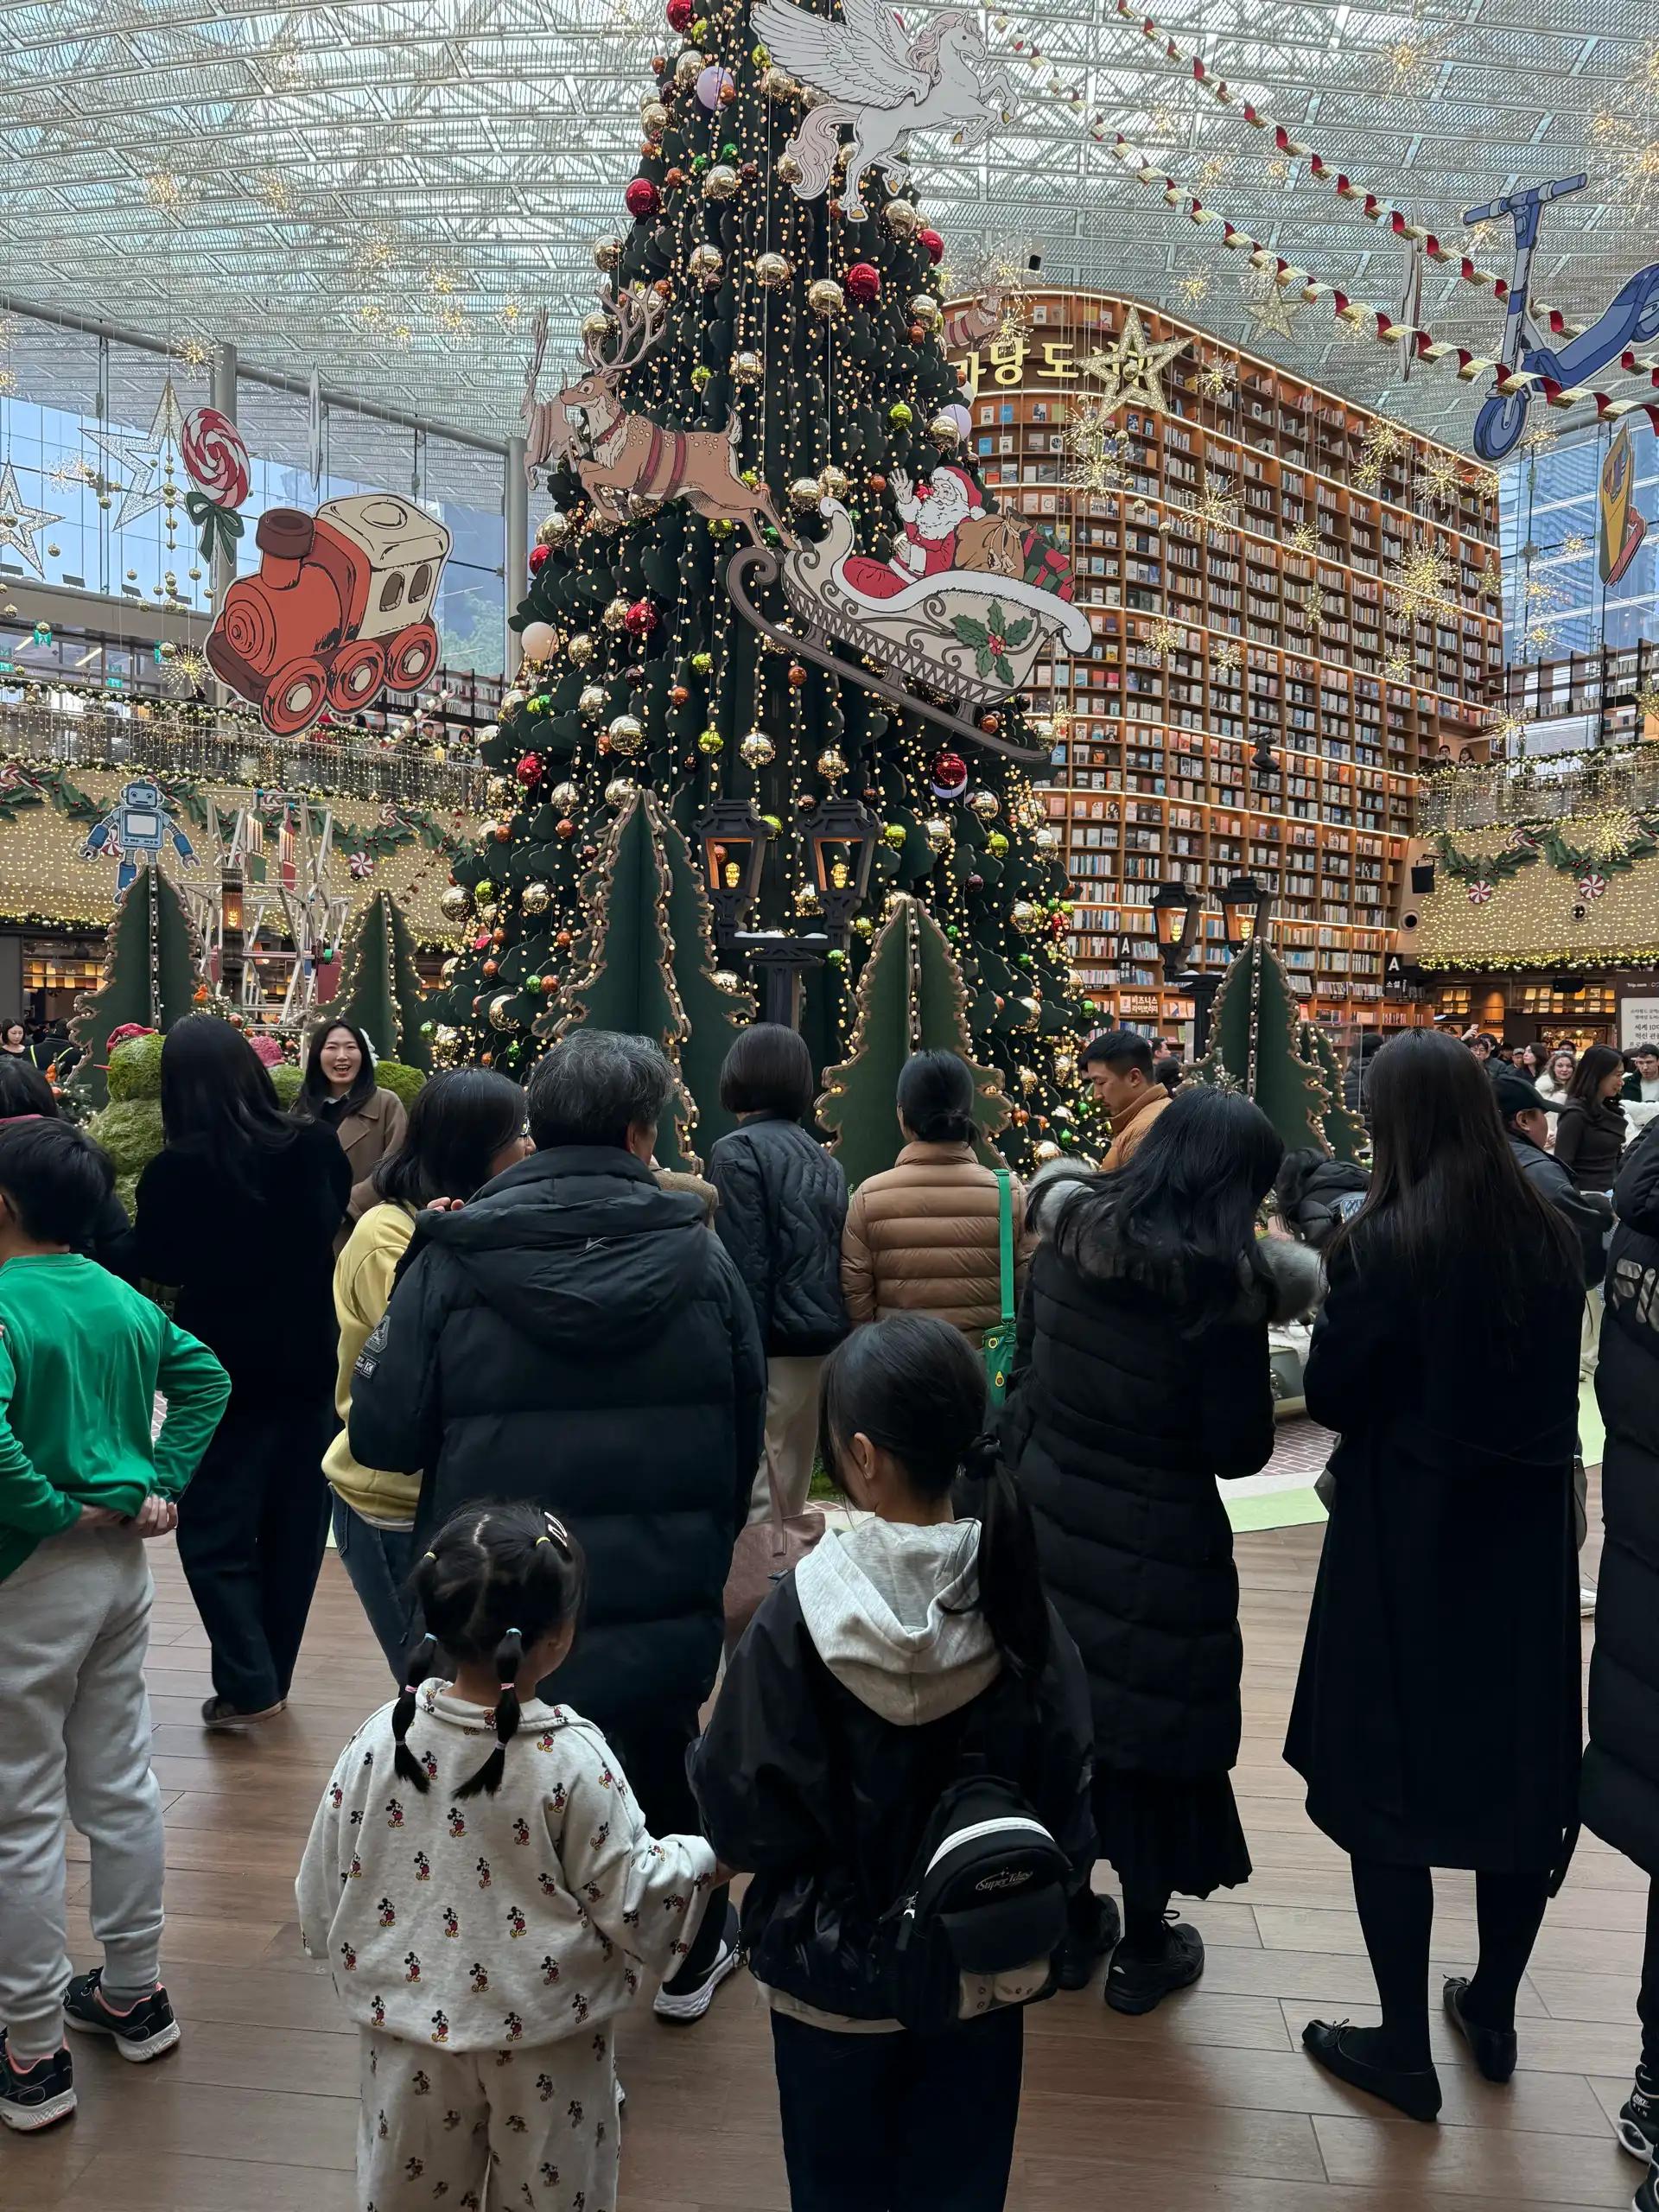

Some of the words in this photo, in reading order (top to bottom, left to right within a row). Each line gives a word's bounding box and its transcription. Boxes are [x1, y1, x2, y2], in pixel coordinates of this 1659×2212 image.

[1121, 938, 1130, 954] A
[1388, 957, 1400, 971] A
[1131, 995, 1158, 1005] 비즈니스
